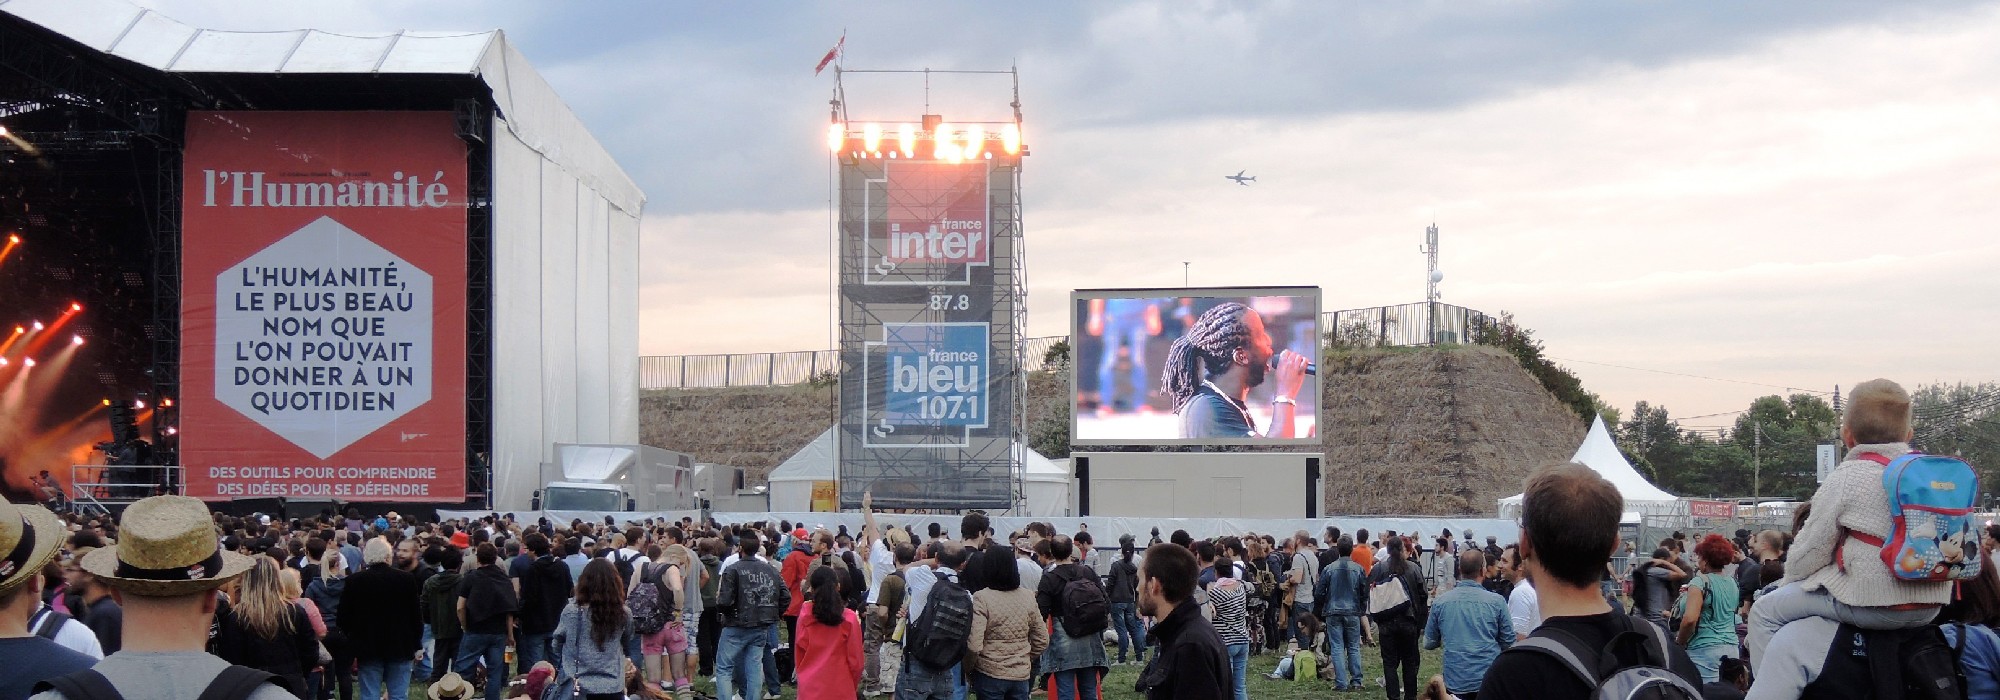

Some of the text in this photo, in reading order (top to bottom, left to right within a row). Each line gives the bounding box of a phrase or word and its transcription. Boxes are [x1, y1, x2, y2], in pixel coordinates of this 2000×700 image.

[202, 169, 448, 208] l’Humanité
[941, 217, 982, 230] france
[891, 223, 982, 259] inter
[242, 261, 406, 290] L'HUMANITÉ,
[235, 292, 413, 311] LE PLUS BEAU
[930, 294, 970, 311] 87.8
[263, 317, 385, 340] NOM QUE
[236, 341, 413, 361] L'ON POUVAIT
[929, 349, 978, 362] france
[234, 360, 413, 386] DONNER À UN
[893, 356, 978, 393] bleu
[250, 391, 395, 416] QUOTIDIEN
[917, 395, 977, 419] 107.1
[209, 466, 436, 479] DES OUTILS POUR COMPRENDRE
[217, 481, 429, 496] DES IDÉES POUR SE DÉFENDRE
